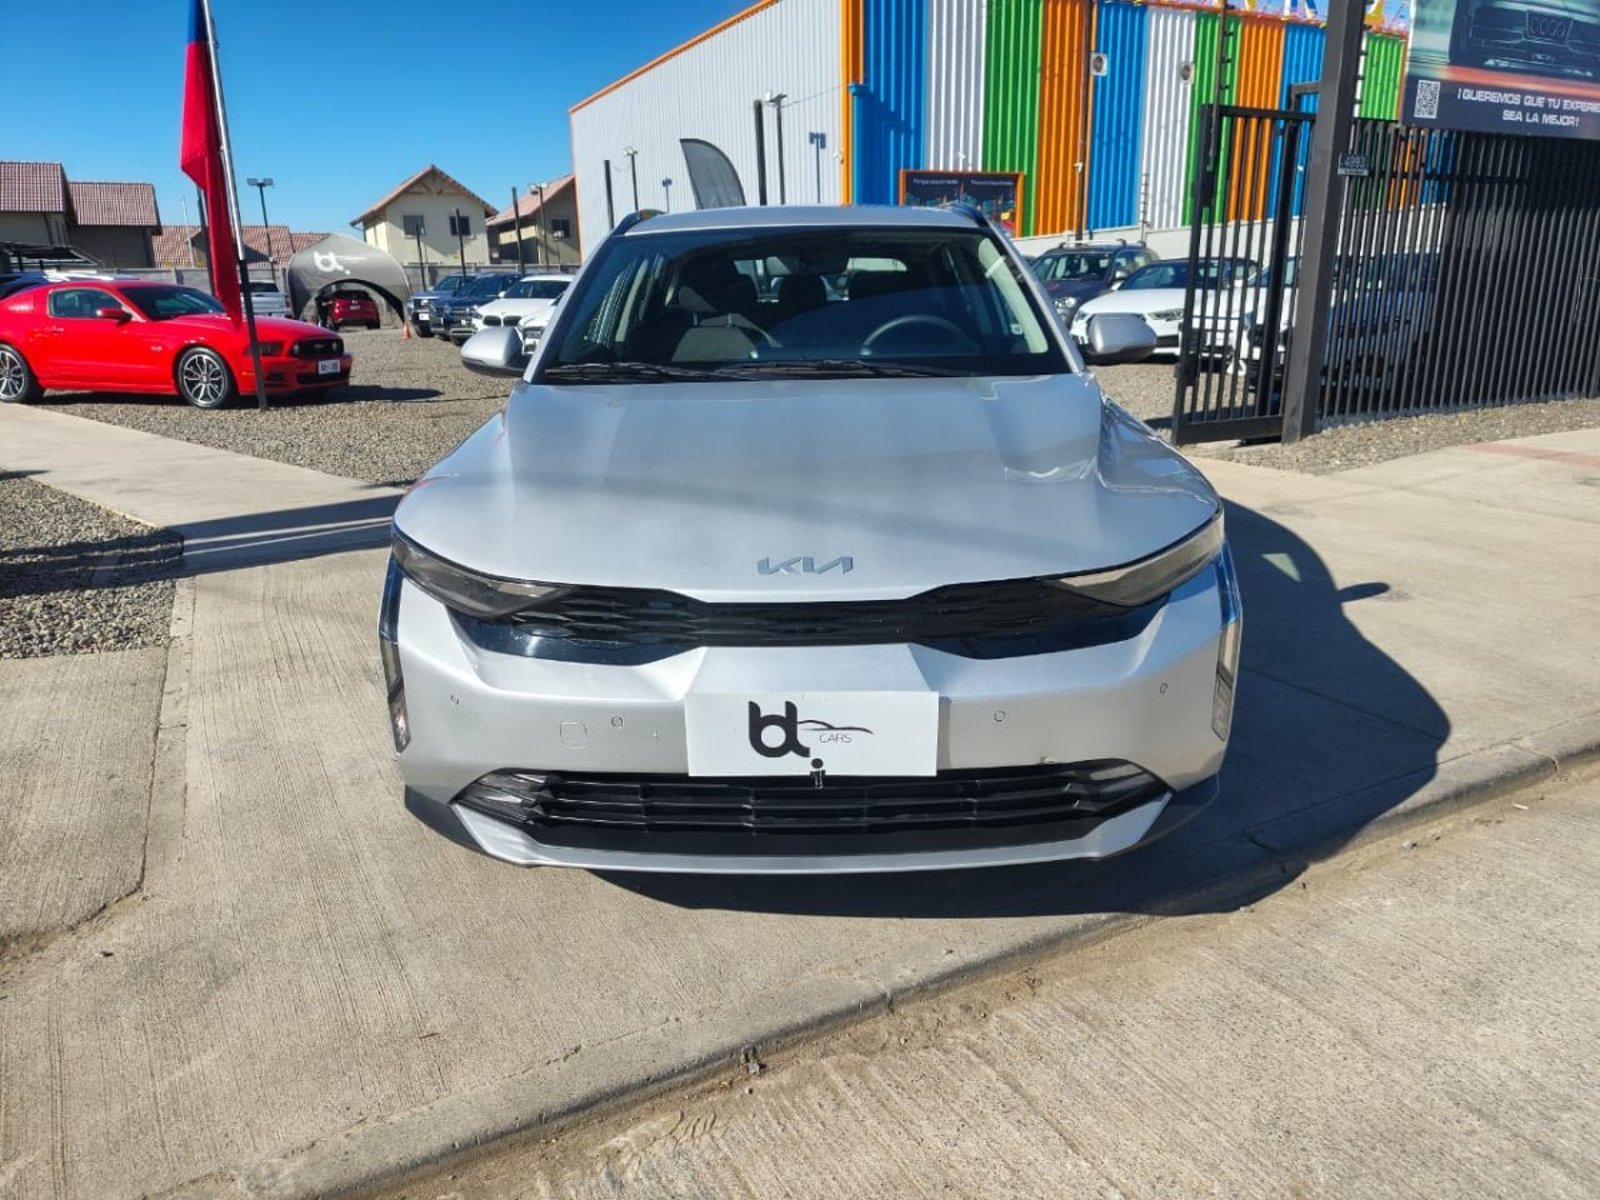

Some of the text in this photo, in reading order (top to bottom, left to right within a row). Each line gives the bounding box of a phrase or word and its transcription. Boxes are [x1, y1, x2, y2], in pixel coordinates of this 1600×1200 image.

[1524, 95, 1545, 108] QUE
[1547, 98, 1561, 109] TU
[1502, 109, 1522, 122] SEA
[1525, 112, 1539, 123] LA
[757, 556, 853, 575] KIA
[819, 733, 853, 744] CARS
